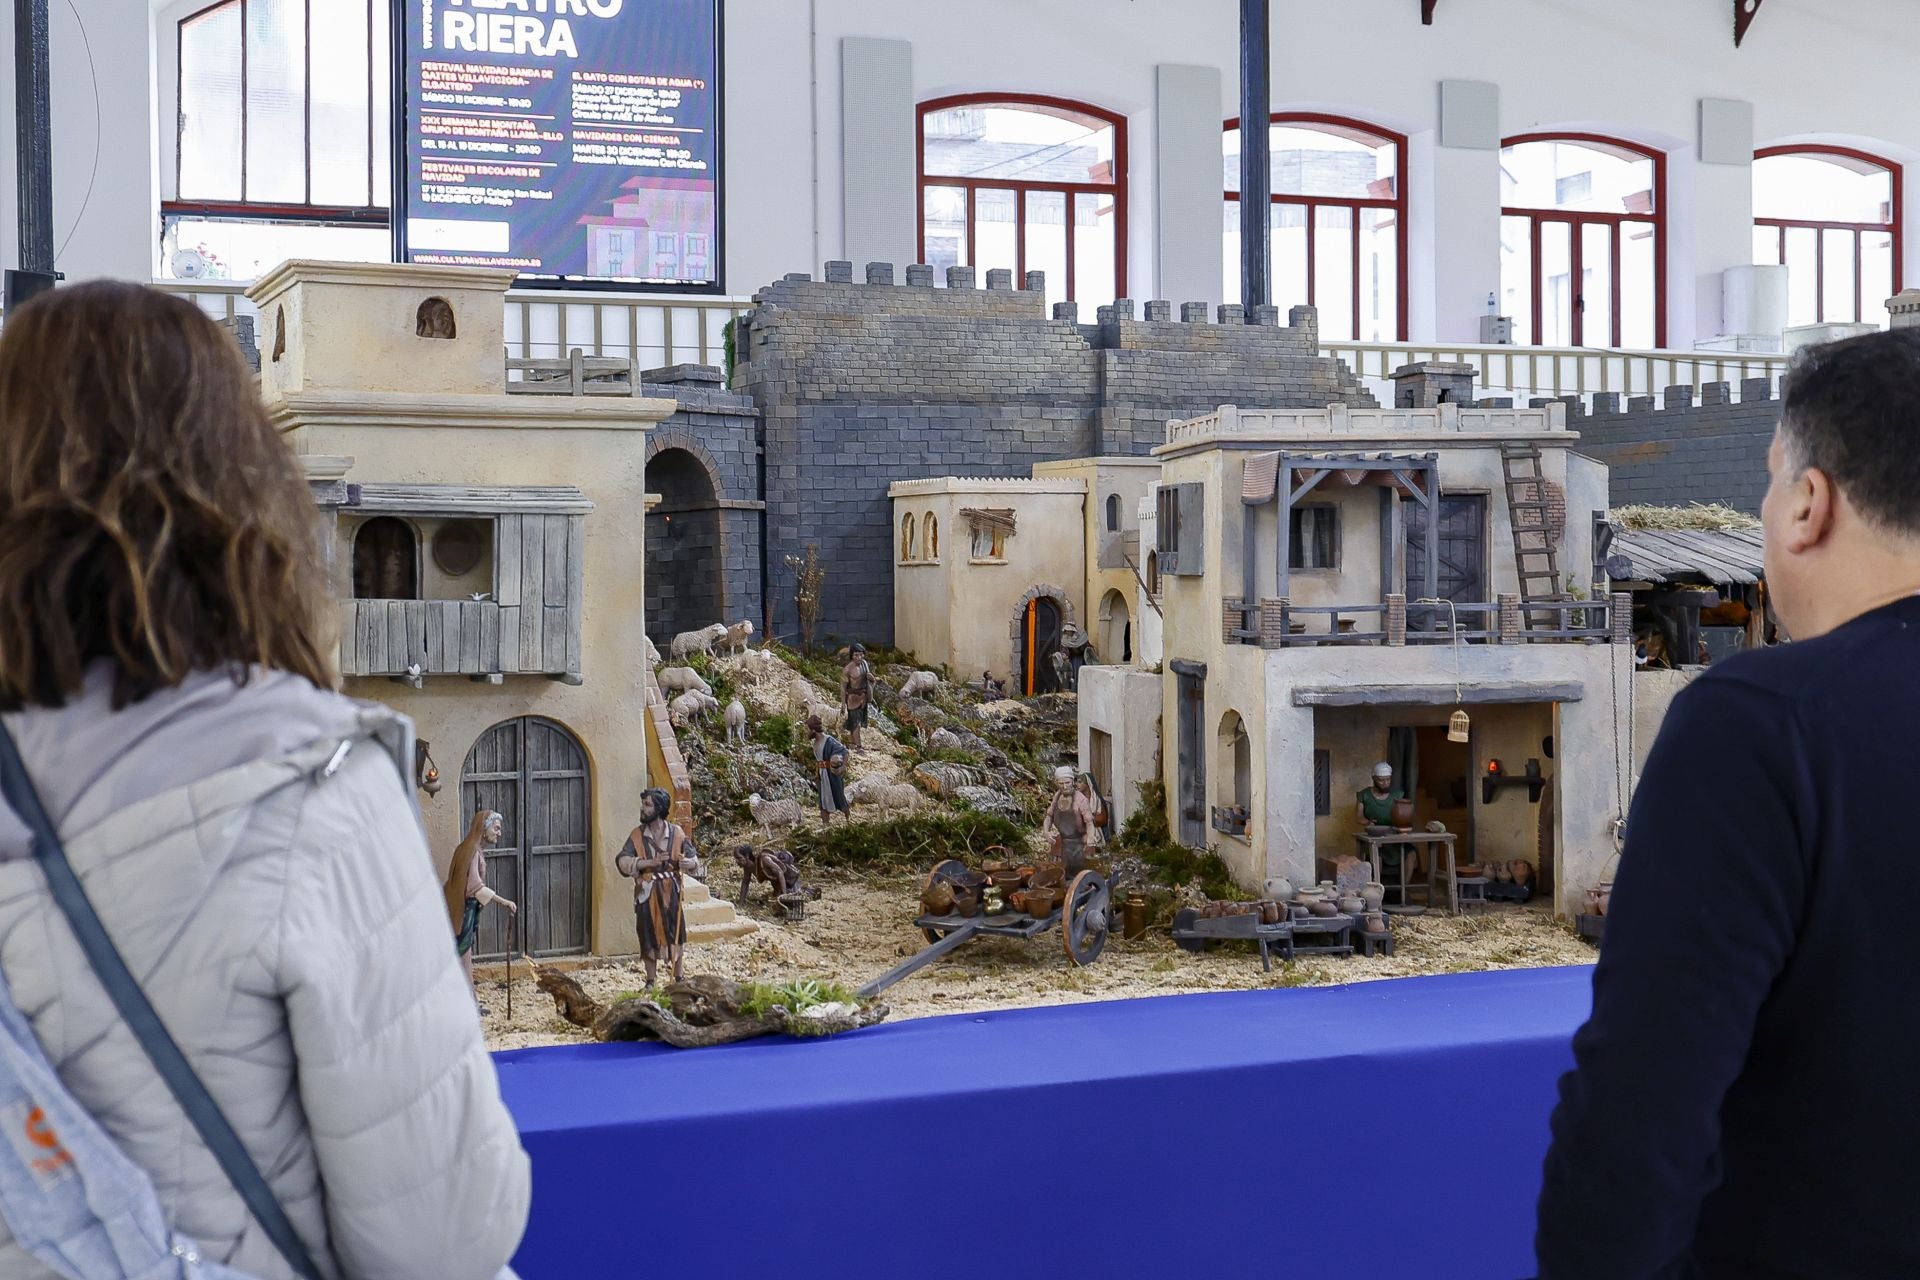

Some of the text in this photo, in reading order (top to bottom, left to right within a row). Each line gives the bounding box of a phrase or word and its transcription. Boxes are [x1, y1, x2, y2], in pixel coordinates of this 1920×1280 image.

[422, 0, 432, 50] OGRAMA
[443, 10, 578, 58] RIERA
[422, 62, 553, 79] FESTIVAL NAVIDAD BANDA DE
[422, 72, 456, 81] GAITES
[572, 72, 583, 81] EL
[583, 73, 607, 82] GATO
[608, 74, 627, 83] CON
[628, 76, 656, 85] BOTAS
[657, 77, 668, 86] DE
[668, 78, 693, 87] AGUA
[421, 116, 535, 130] XXX SEMANA DE MONTAÑA
[421, 124, 452, 133] GRUPO
[453, 127, 463, 135] DE
[465, 127, 509, 138] MONTAÑA
[572, 131, 680, 145] NAVIDADES CON CIENCIA
[422, 139, 437, 149] DEL
[448, 140, 458, 150] AL
[572, 144, 605, 154] MARTES
[422, 163, 541, 177] FESTIVALES ESCOLARES DE
[422, 172, 465, 182] NAVIDAD
